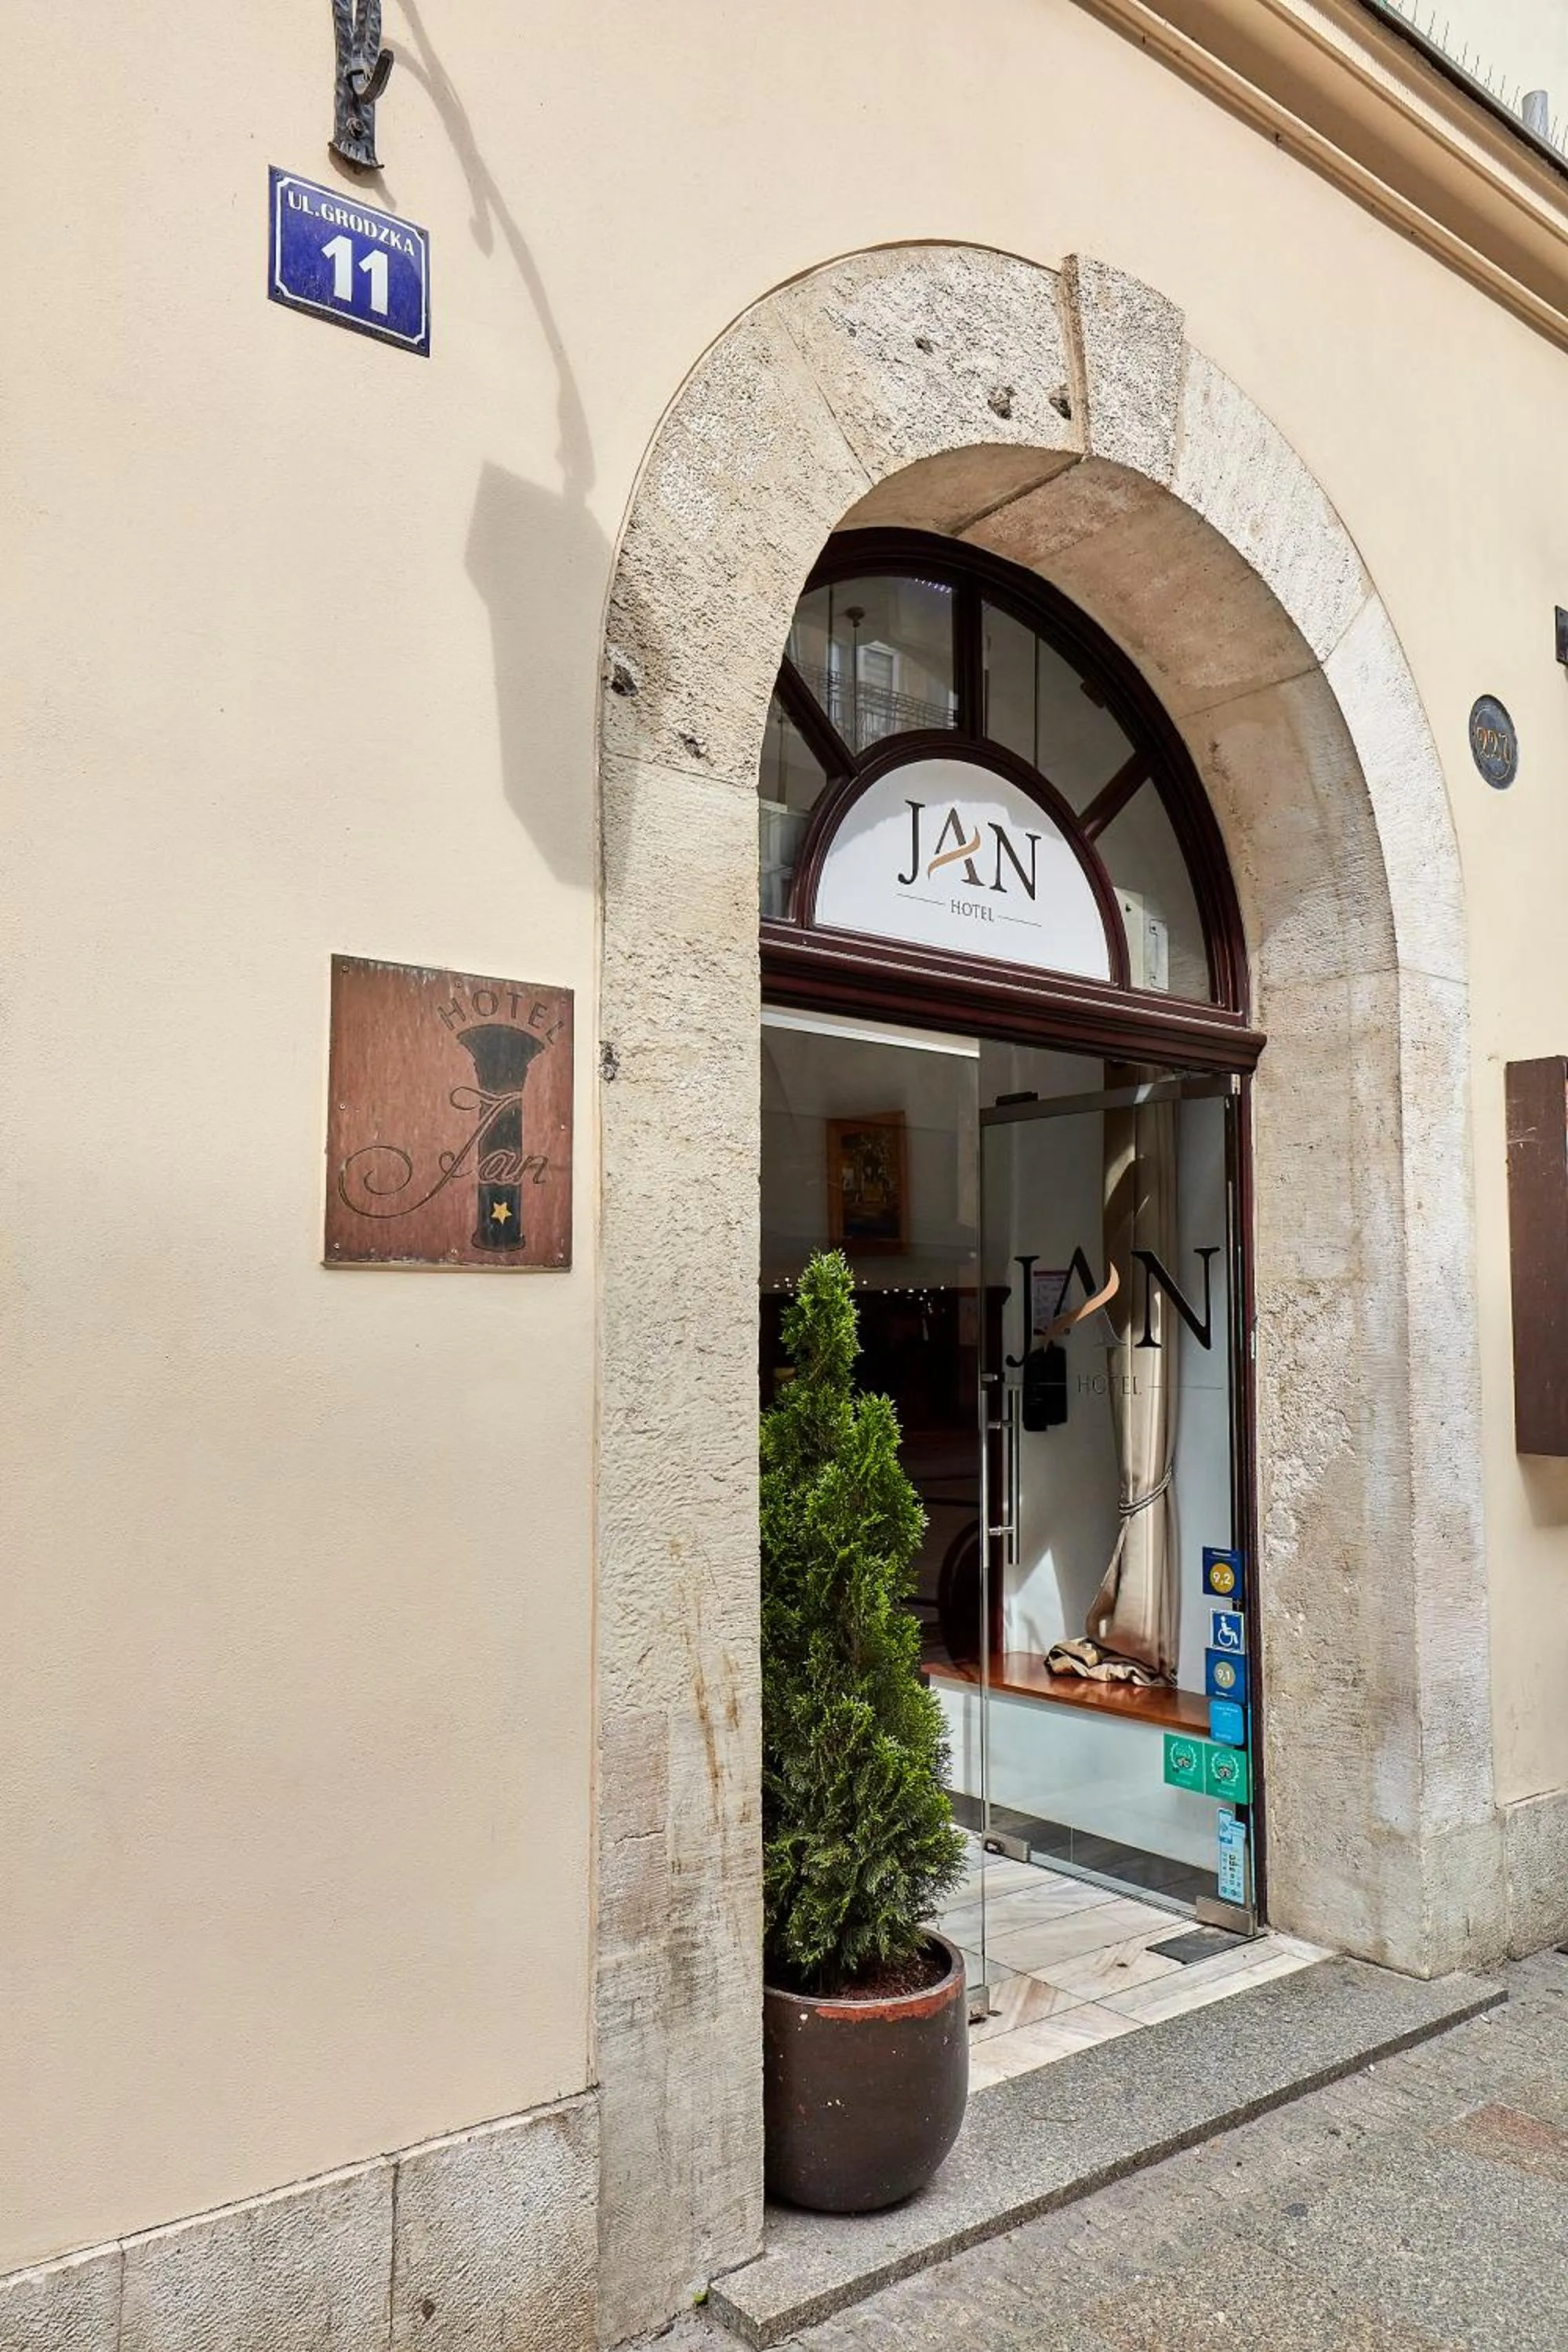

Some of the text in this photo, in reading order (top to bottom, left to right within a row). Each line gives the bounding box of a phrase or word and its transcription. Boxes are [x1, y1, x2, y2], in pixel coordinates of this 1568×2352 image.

[288, 190, 414, 256] UL.GRODZKA
[321, 234, 388, 315] 11
[898, 800, 1041, 901] JAN
[951, 899, 994, 922] HOTEL
[438, 990, 564, 1045] HOTEL
[339, 1086, 549, 1218] Jan
[1005, 1246, 1221, 1368] JAN
[1078, 1374, 1142, 1396] HOTEL
